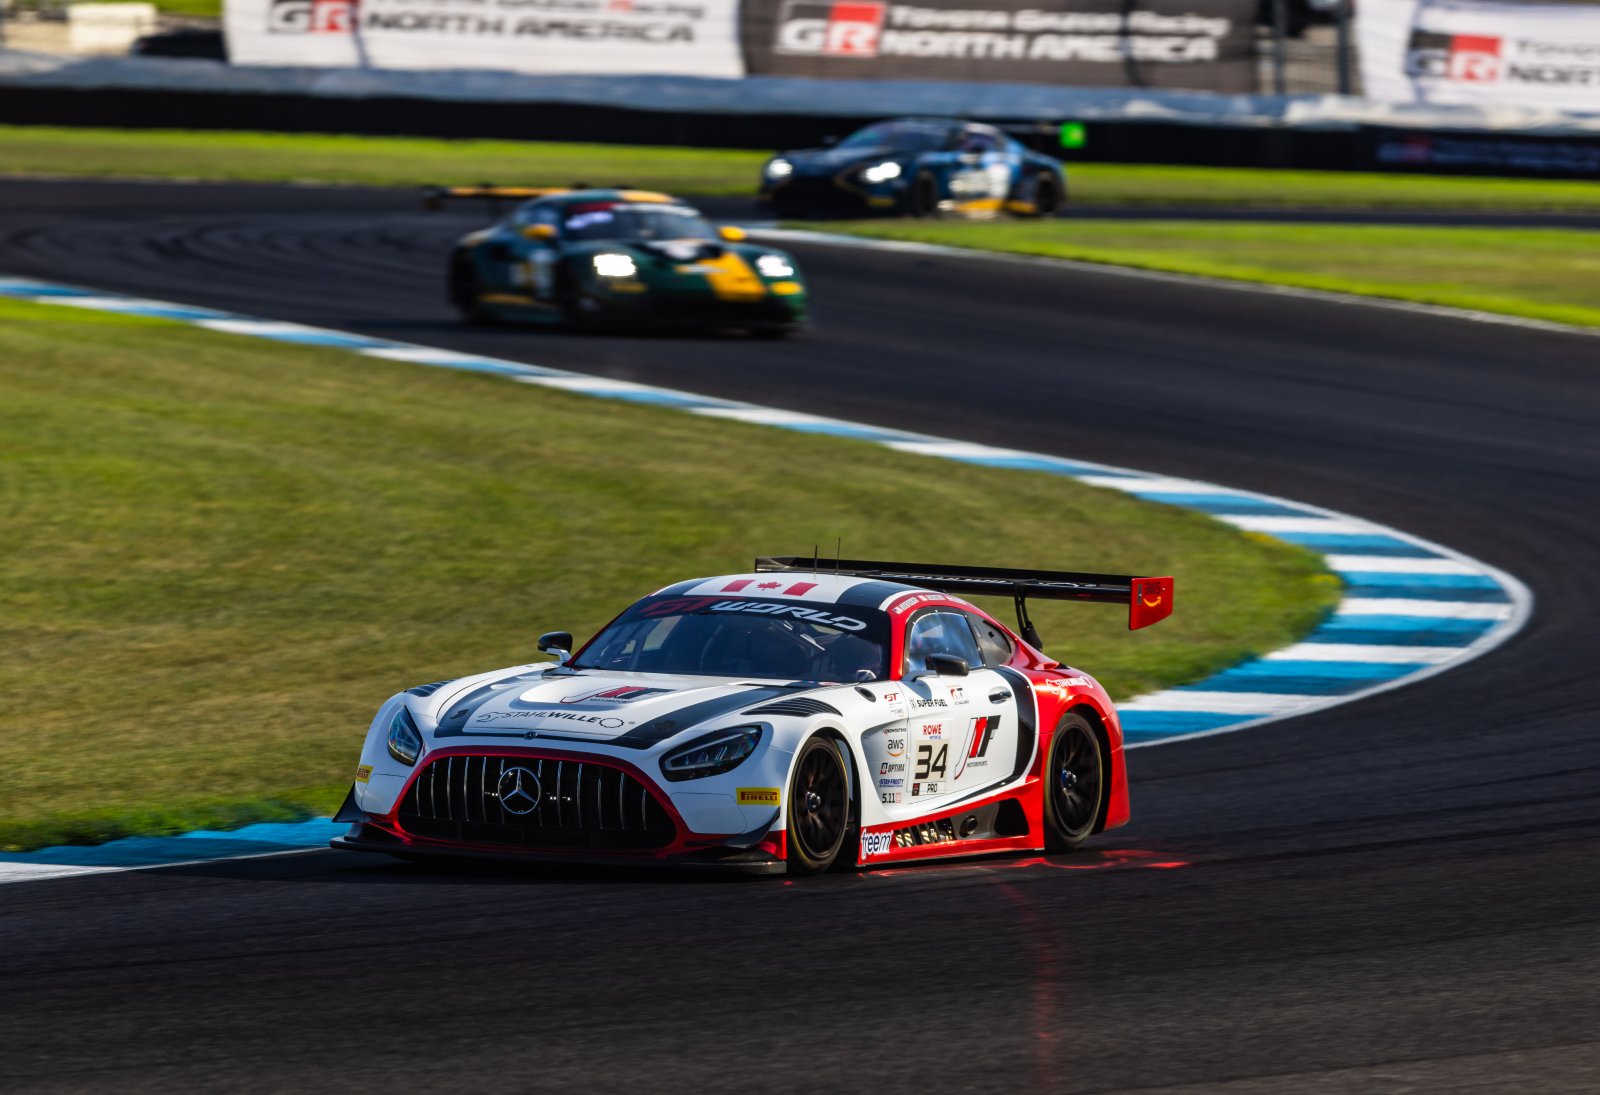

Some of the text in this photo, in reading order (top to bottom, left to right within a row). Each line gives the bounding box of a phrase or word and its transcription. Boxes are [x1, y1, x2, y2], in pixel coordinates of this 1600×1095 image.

[366, 12, 693, 42] NORTH AMERICA
[780, 19, 881, 53] GR
[1127, 11, 1230, 40] Racing
[881, 30, 1218, 63] NORTH AMERICA
[1508, 64, 1600, 85] NORT
[708, 601, 868, 631] WORLD
[917, 699, 934, 708] SUPER
[935, 698, 948, 707] FUEL
[502, 711, 601, 724] STAHLWILLE
[923, 724, 942, 736] ROWE
[887, 739, 904, 750] aws
[914, 743, 949, 780] 34
[740, 791, 778, 801] PIRELLI
[881, 792, 896, 804] 5.11
[926, 783, 938, 793] PRO
[862, 829, 895, 858] freem
